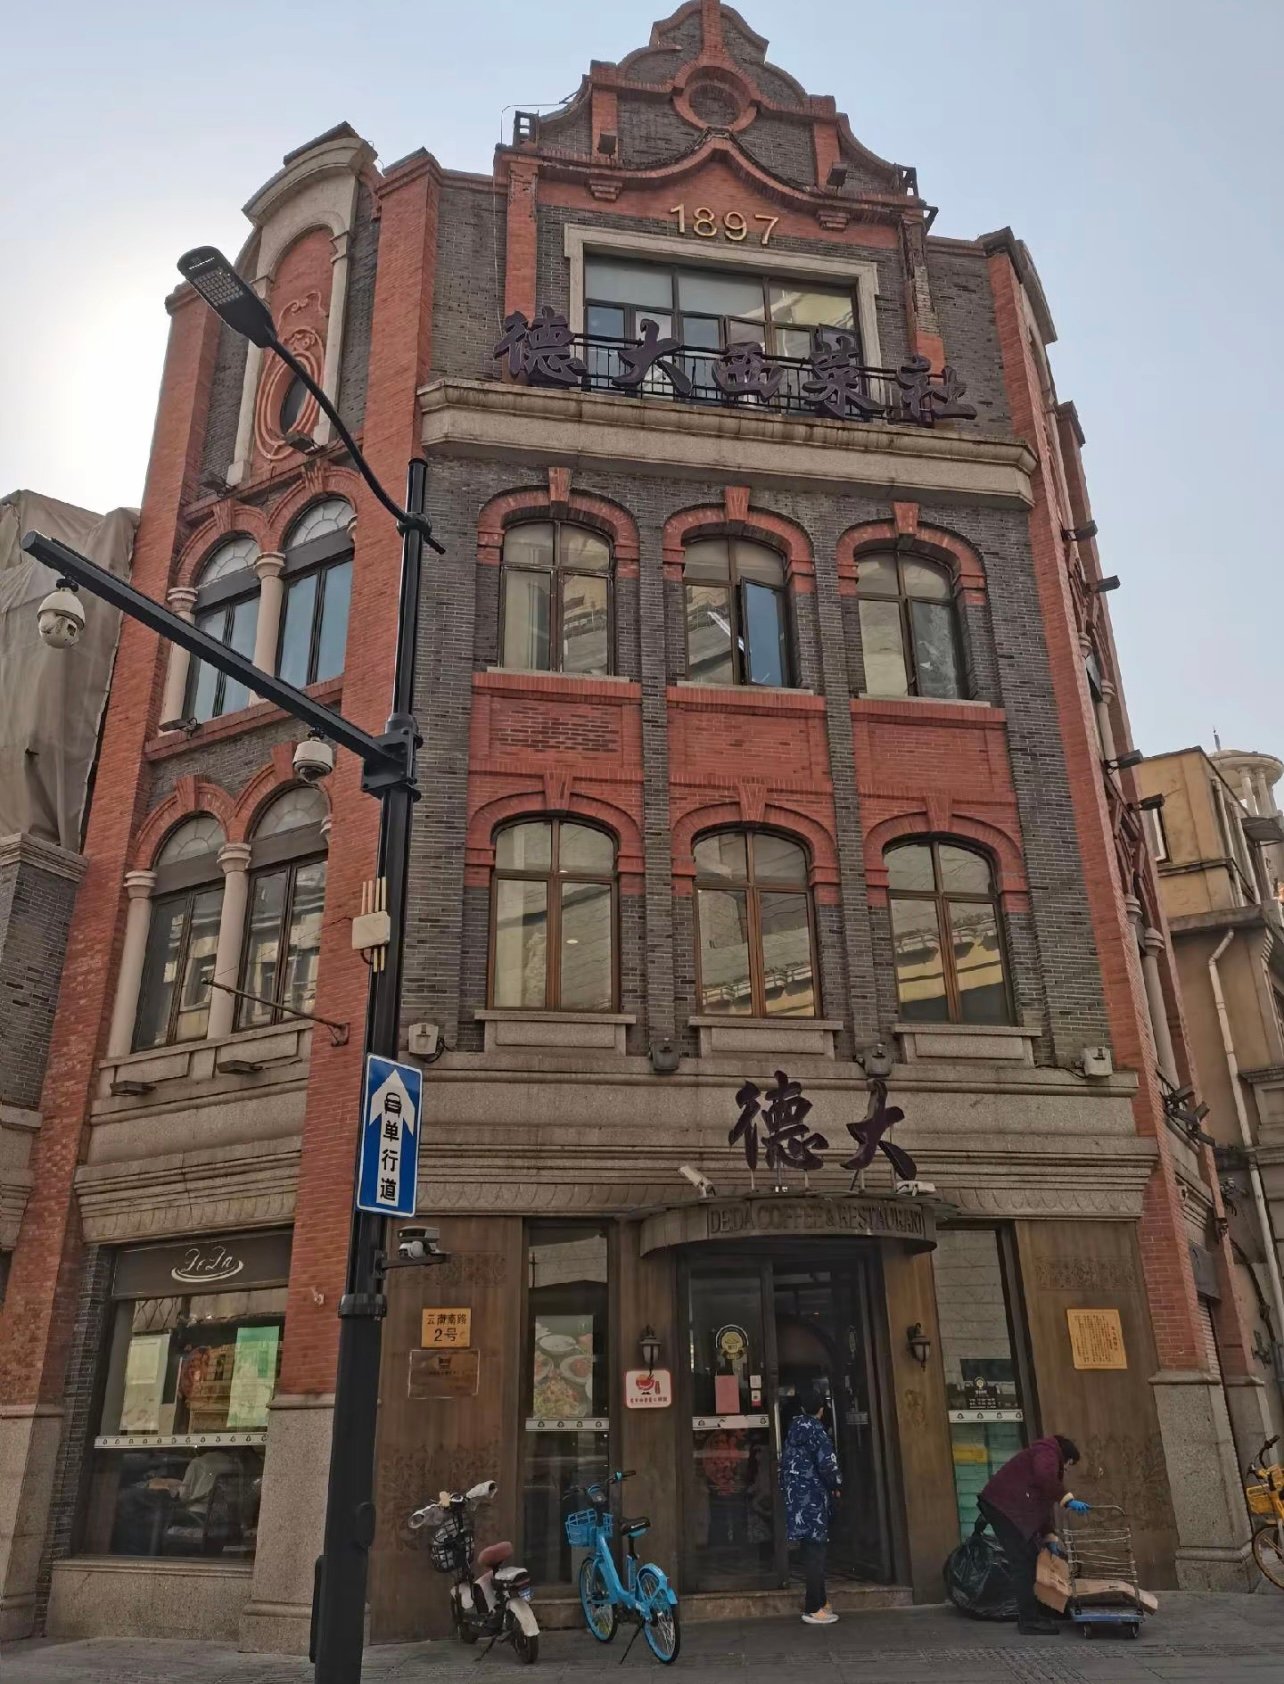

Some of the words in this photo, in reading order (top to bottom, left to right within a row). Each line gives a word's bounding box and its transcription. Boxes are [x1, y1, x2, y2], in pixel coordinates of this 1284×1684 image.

[670, 203, 780, 246] 1897
[493, 304, 977, 421] 德大西菜社
[728, 1070, 917, 1181] 德大
[379, 1120, 400, 1201] 单行道
[756, 1204, 824, 1230] COFFEE
[433, 1327, 458, 1342] 2号
